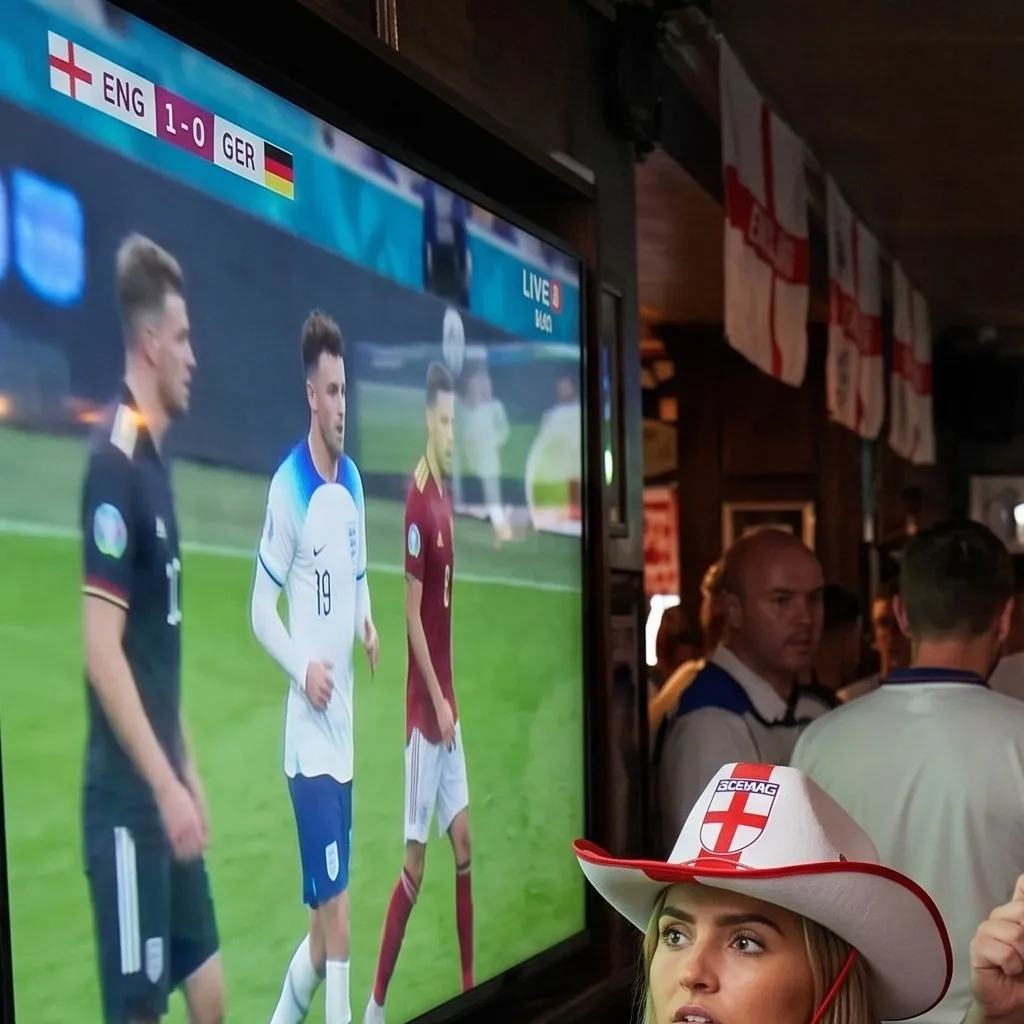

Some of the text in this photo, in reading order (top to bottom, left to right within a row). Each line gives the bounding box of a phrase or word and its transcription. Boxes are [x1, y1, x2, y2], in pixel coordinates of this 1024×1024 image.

[103, 71, 256, 171] ENG 1-0 GER
[522, 268, 550, 308] LIVE
[315, 568, 331, 616] 19
[443, 564, 450, 608] 8
